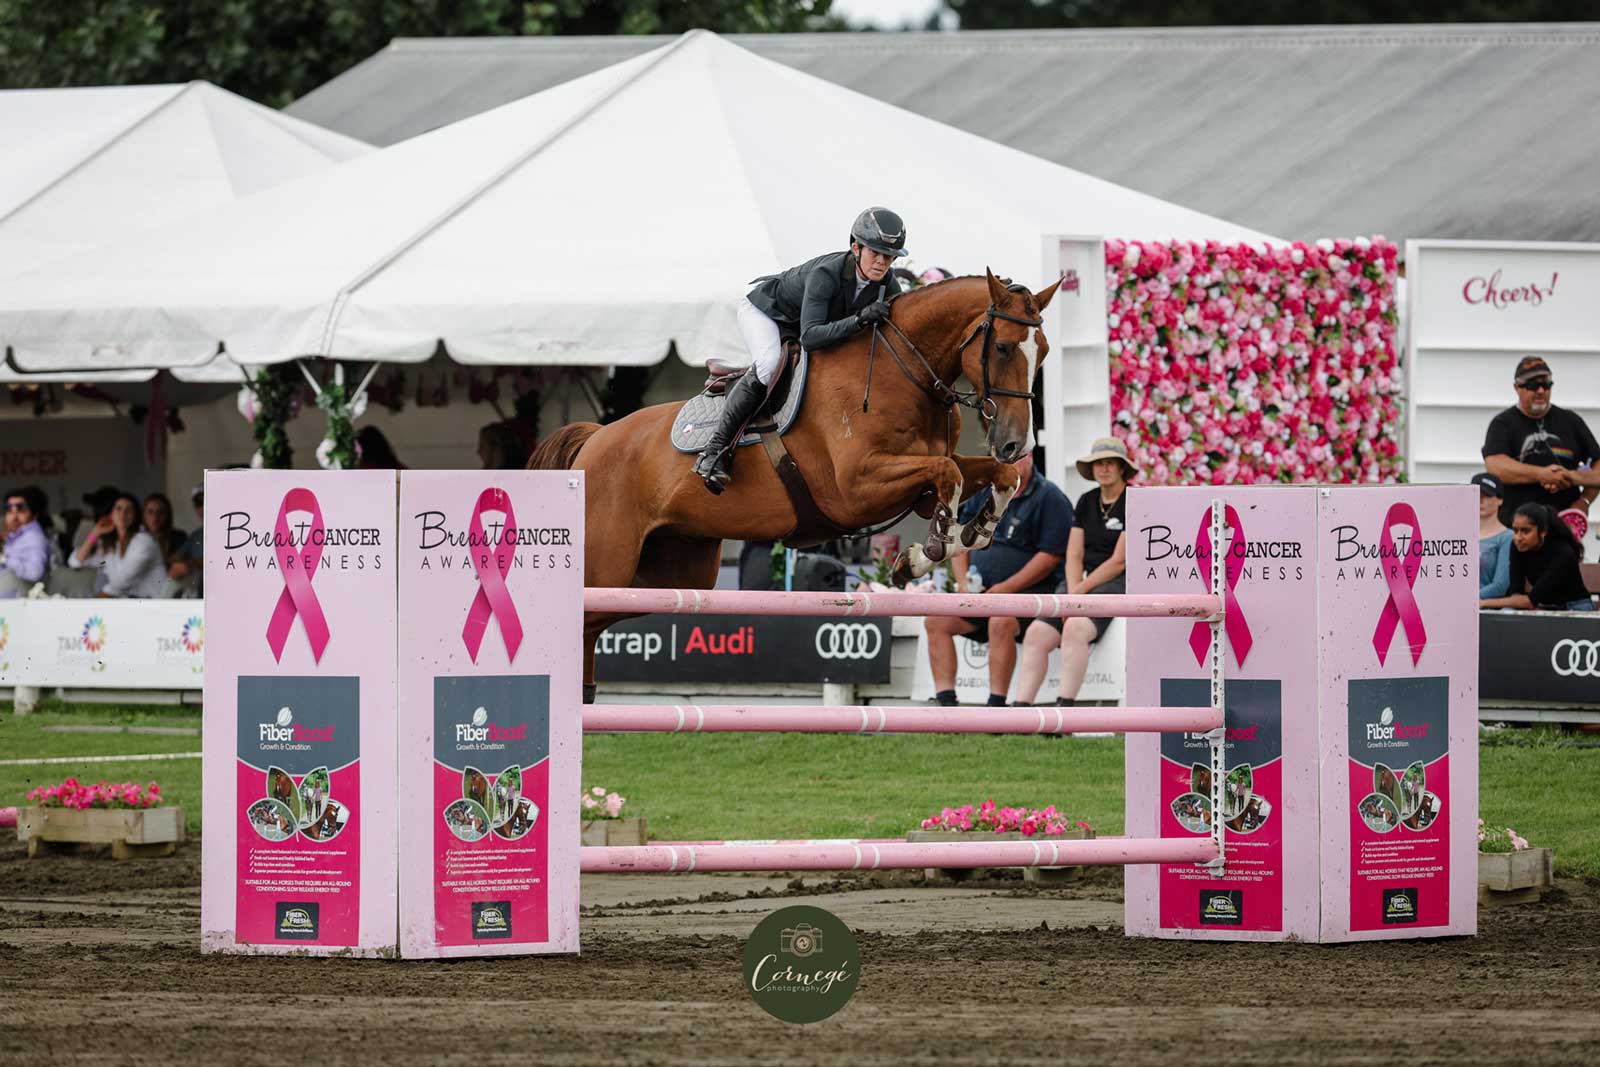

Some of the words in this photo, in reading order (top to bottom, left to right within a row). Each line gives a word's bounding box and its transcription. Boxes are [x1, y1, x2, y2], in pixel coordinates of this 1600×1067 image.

[1463, 269, 1558, 310] Cheers!
[220, 511, 311, 550] Breast
[312, 528, 381, 546] CANCER
[414, 511, 504, 550] Breast
[505, 528, 570, 546] CANCER
[1140, 525, 1232, 561] Brea
[1233, 542, 1302, 559] CANCER
[1330, 525, 1412, 562] Breast
[1412, 540, 1468, 556] CANCER
[226, 555, 382, 570] AWARENESS
[420, 554, 572, 570] AWARENESS
[1147, 566, 1303, 580] AWAENESS
[1337, 564, 1469, 580] AWARENESS
[684, 626, 754, 654] Audi
